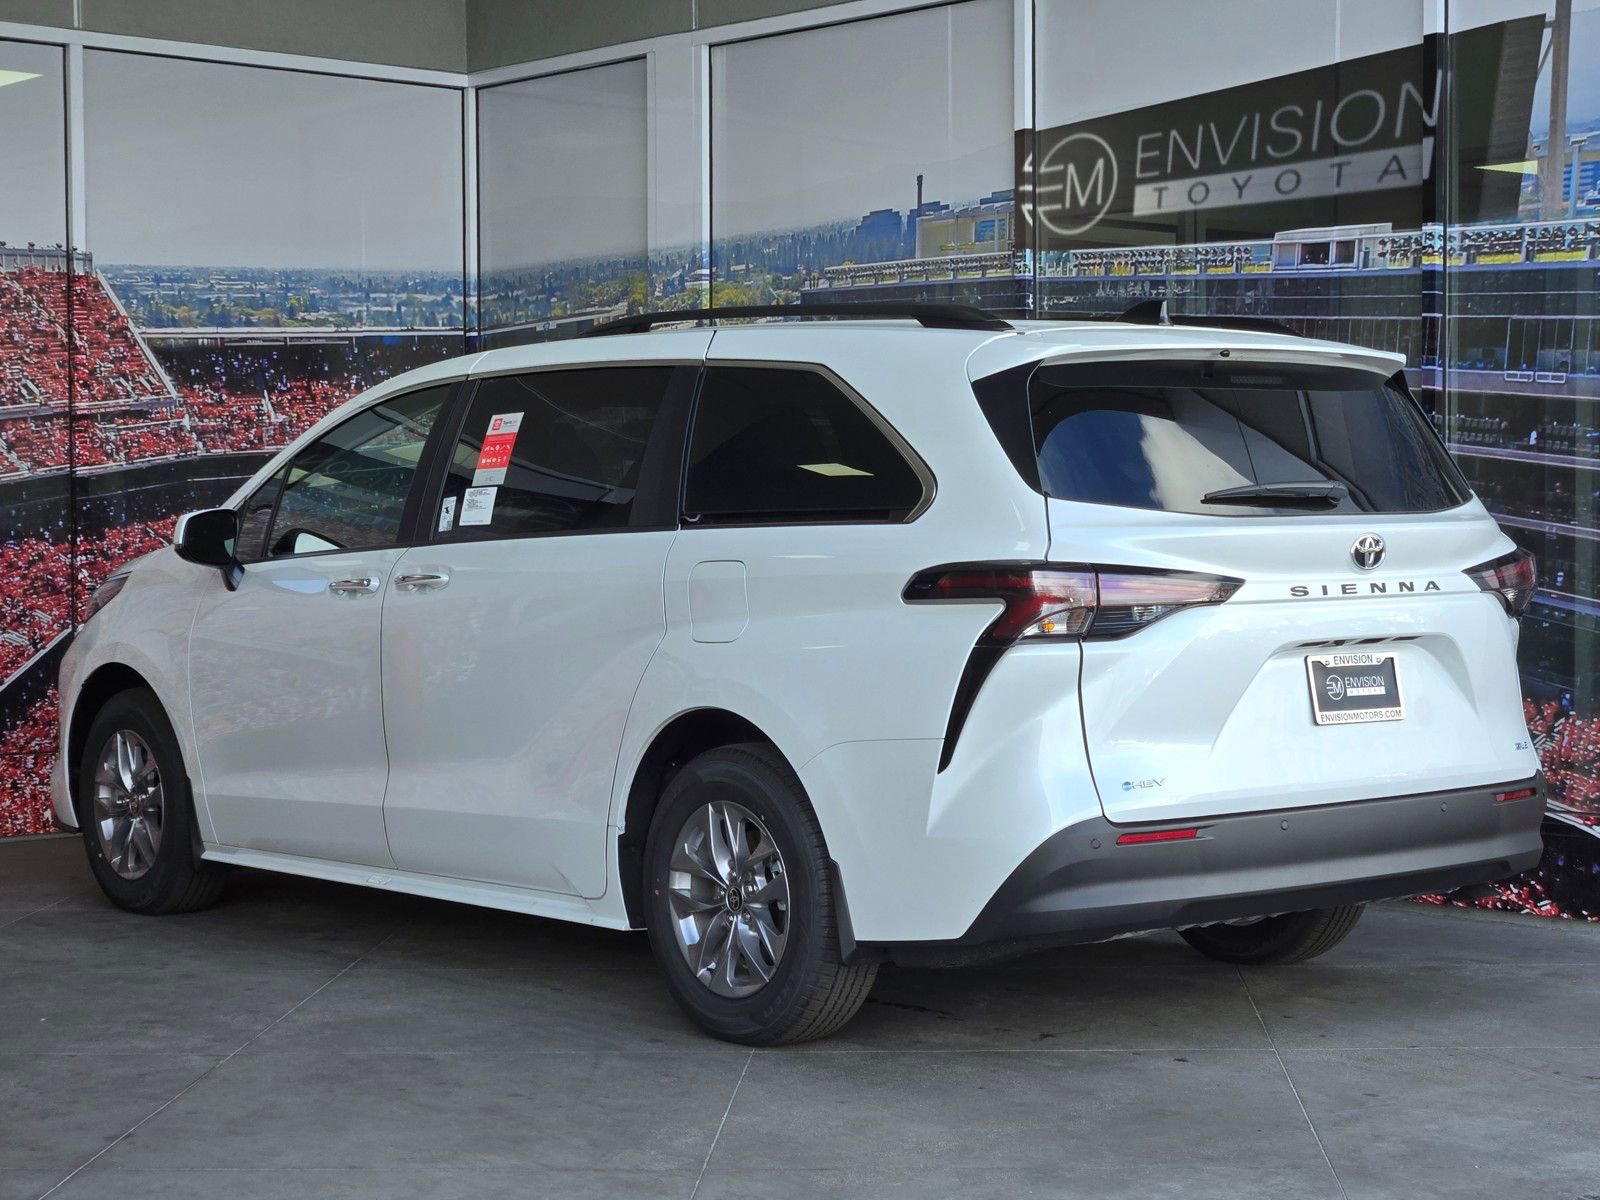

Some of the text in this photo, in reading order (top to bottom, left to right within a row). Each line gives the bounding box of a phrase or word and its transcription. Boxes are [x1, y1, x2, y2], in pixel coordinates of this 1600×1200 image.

[1136, 69, 1443, 179] ENVISION
[1153, 155, 1407, 209] TOYOTA
[1290, 580, 1441, 597] SIENNA
[1333, 654, 1373, 665] ENVISION
[1344, 675, 1385, 688] ENVISION
[1320, 709, 1402, 723] ENVISIONMOTORS.COM
